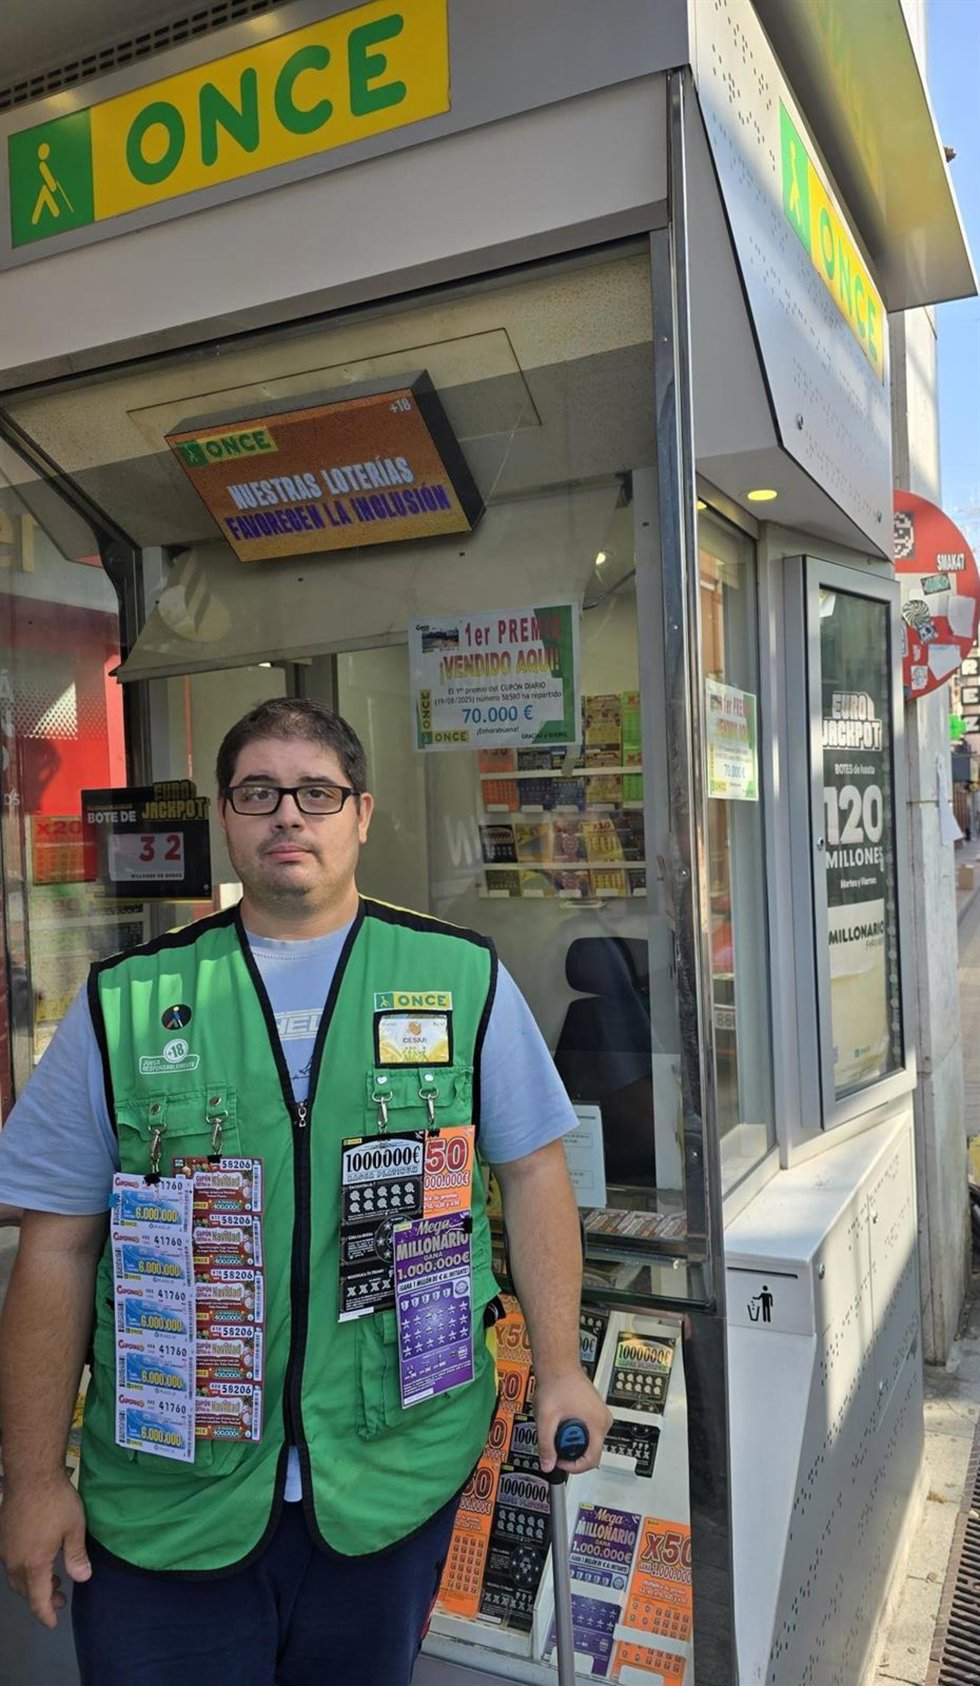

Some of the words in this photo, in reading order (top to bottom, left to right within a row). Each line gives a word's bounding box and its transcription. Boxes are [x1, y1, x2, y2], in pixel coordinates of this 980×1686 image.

[126, 13, 406, 185] ONCE
[819, 207, 878, 361] ONCE
[390, 399, 412, 413] +18
[205, 429, 272, 458] ONCE
[226, 472, 323, 510] NUESTRAS
[320, 455, 416, 495] LOTERÍAS
[323, 502, 354, 527] LA
[465, 622, 491, 647] 1er
[525, 681, 546, 690] DIARIO
[531, 690, 562, 700] repartido
[421, 690, 431, 729] ONCE
[462, 705, 518, 723] 70.000
[523, 704, 534, 720] €
[832, 692, 869, 720] EURO
[434, 731, 467, 742] ONCE
[821, 719, 881, 750] JACKPOT
[87, 811, 118, 824] BOTE
[120, 810, 137, 823] DE
[142, 798, 209, 820] JACKPOT
[823, 784, 884, 846] 120
[397, 994, 447, 1006] ONCE
[221, 1160, 251, 1169] 58206
[155, 1181, 183, 1190] 1760
[221, 1215, 251, 1225] 58206
[417, 1219, 450, 1236] Mega
[154, 1236, 182, 1246] 41760
[397, 1231, 469, 1261] MILLONARIO
[423, 1252, 443, 1261] GANA
[398, 1252, 470, 1280] 1.000.000€
[223, 1270, 253, 1280] 58206
[158, 1289, 186, 1301] 41760
[223, 1326, 253, 1336] 58206
[159, 1344, 187, 1357] 41760
[222, 1384, 252, 1394] 58206
[159, 1400, 186, 1414] 41760
[595, 1508, 624, 1526] Mega
[575, 1519, 636, 1546] MILLONARIO
[573, 1540, 633, 1563] 1.000.000€
